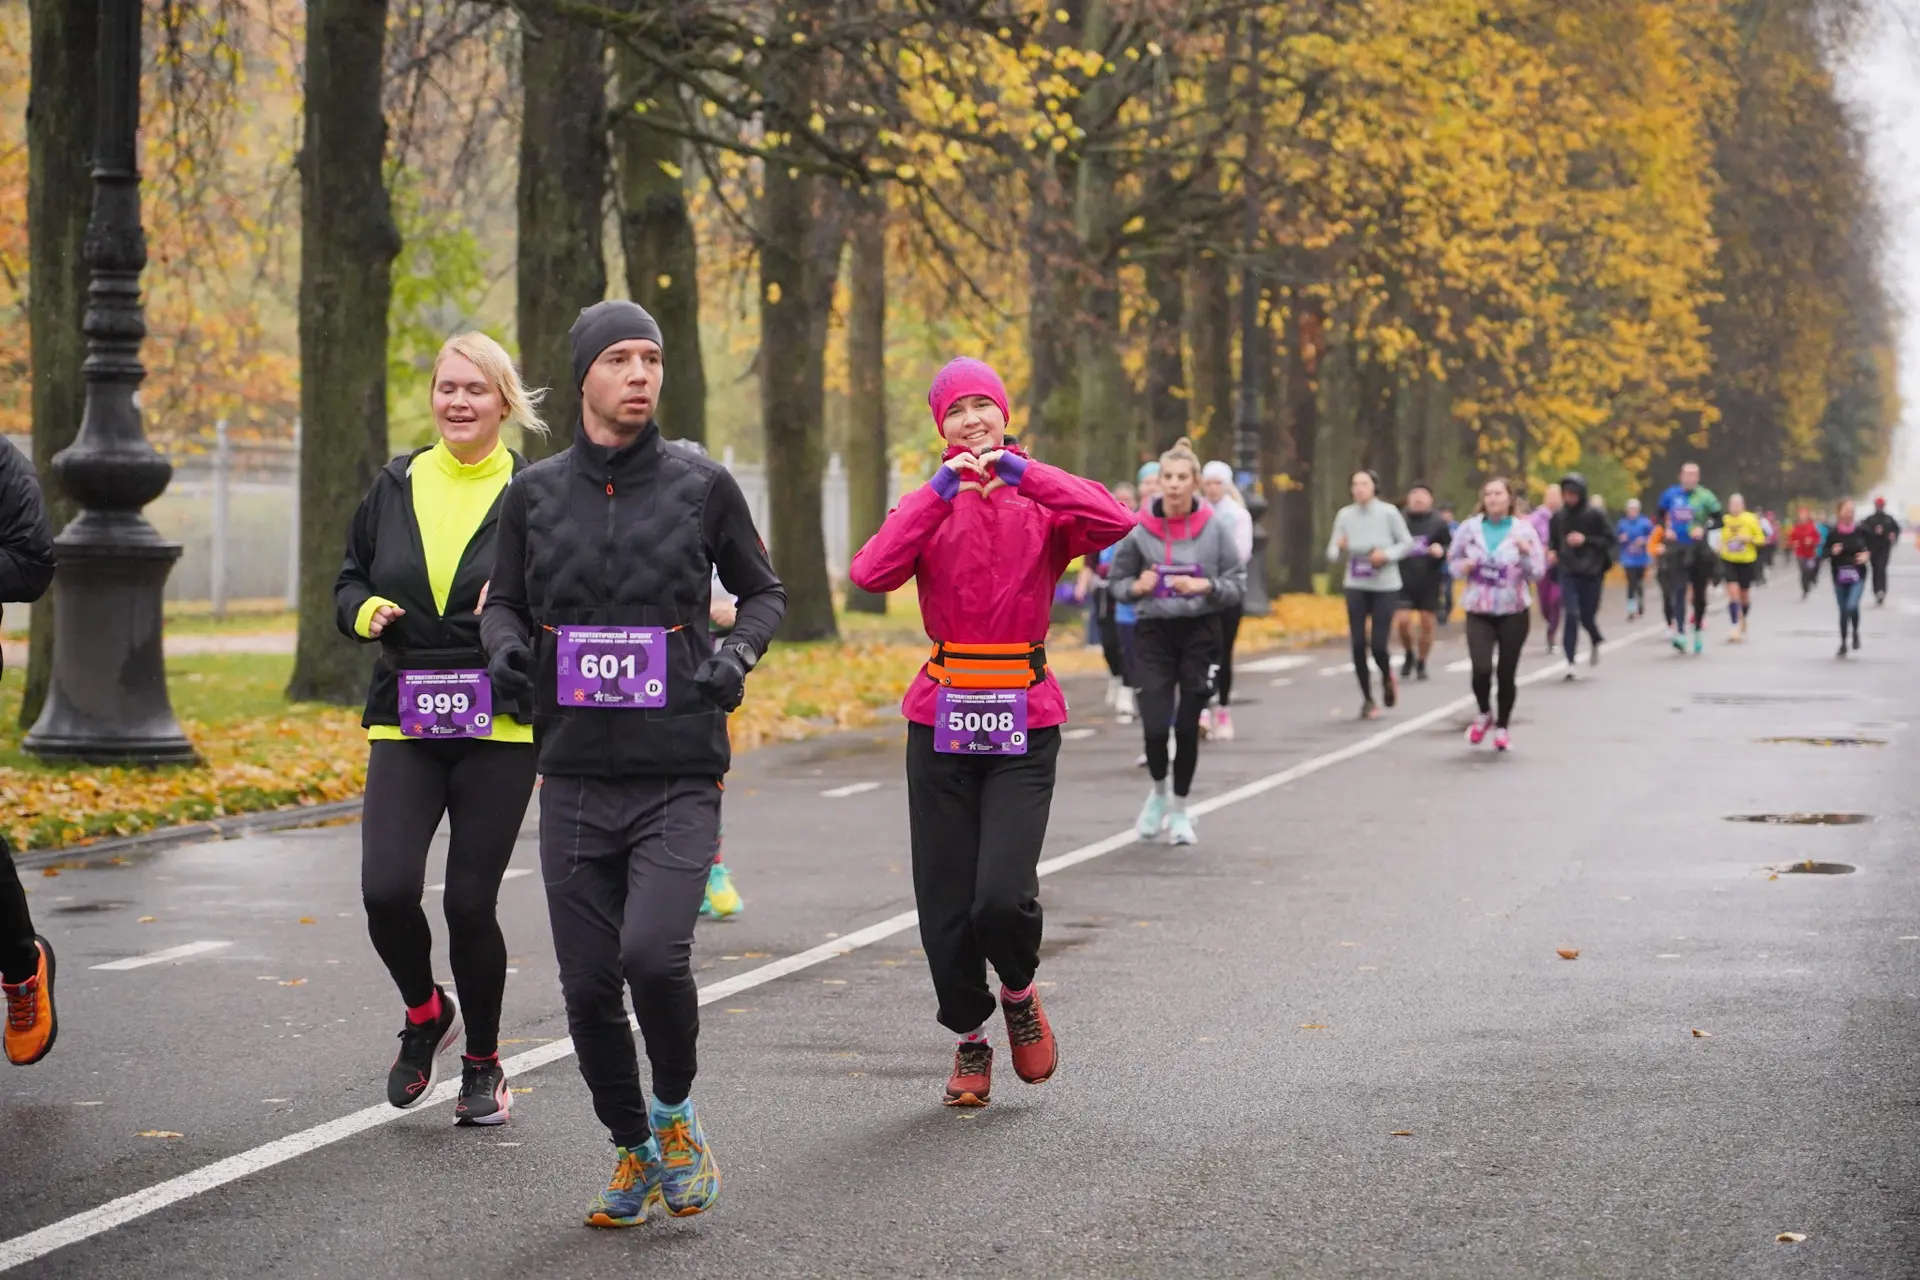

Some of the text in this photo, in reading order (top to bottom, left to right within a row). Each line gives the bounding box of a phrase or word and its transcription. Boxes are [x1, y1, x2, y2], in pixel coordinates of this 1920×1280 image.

[580, 654, 636, 679] 601
[650, 683, 658, 692] D
[417, 693, 469, 714] 999
[478, 716, 486, 724] D
[948, 712, 1014, 732] 5008
